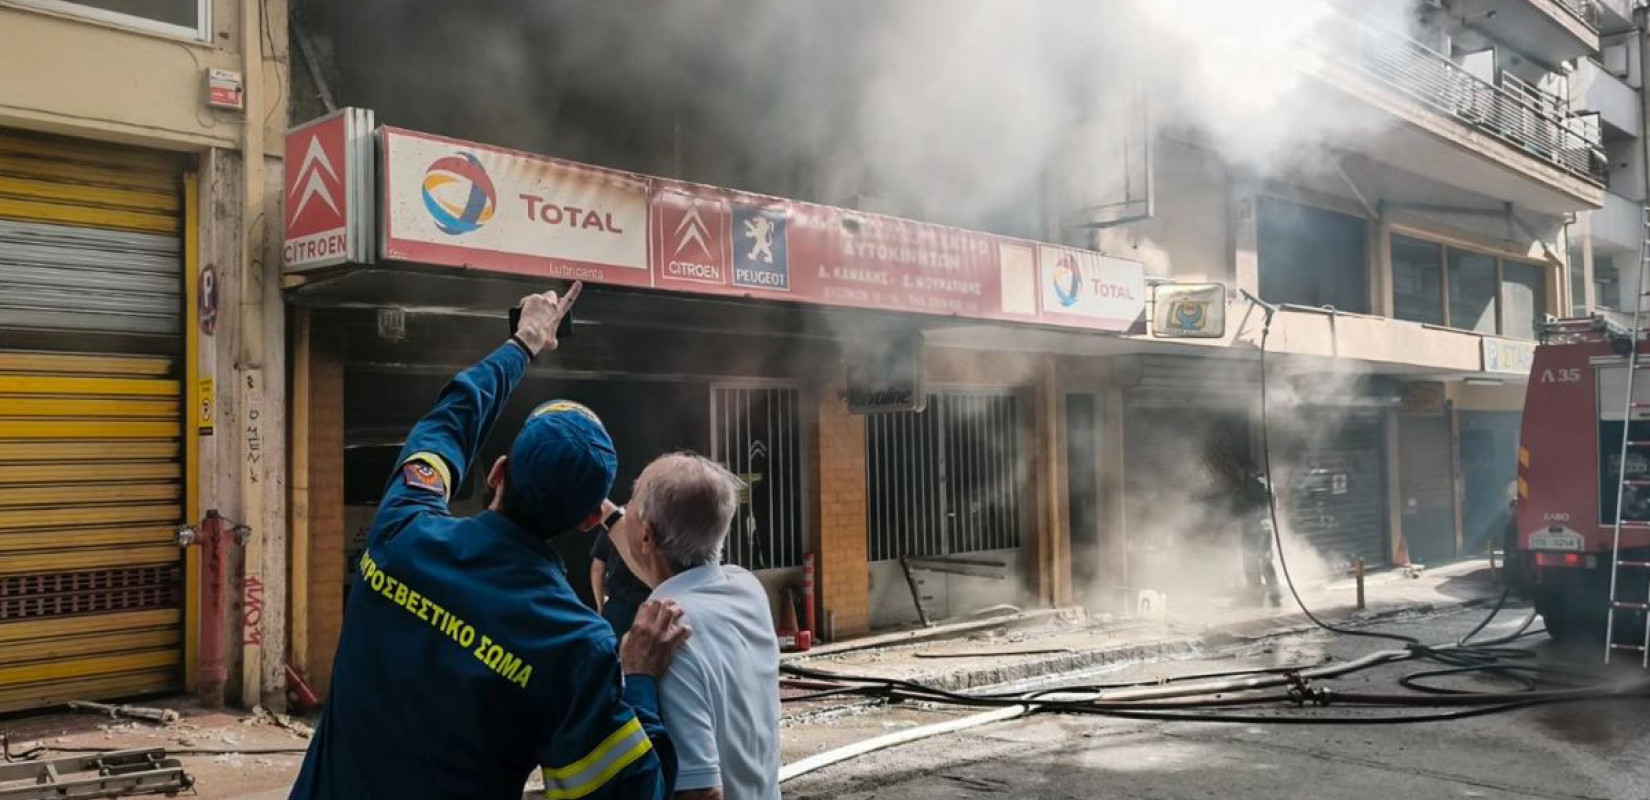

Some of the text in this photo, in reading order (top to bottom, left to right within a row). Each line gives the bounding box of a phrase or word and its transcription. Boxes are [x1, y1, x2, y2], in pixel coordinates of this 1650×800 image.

[519, 193, 623, 235] TOTAL
[669, 260, 720, 280] CITROEN
[736, 267, 786, 286] PEUGEOT
[1090, 277, 1135, 302] TOTAL
[474, 634, 533, 689] ΣΩΜΑ
